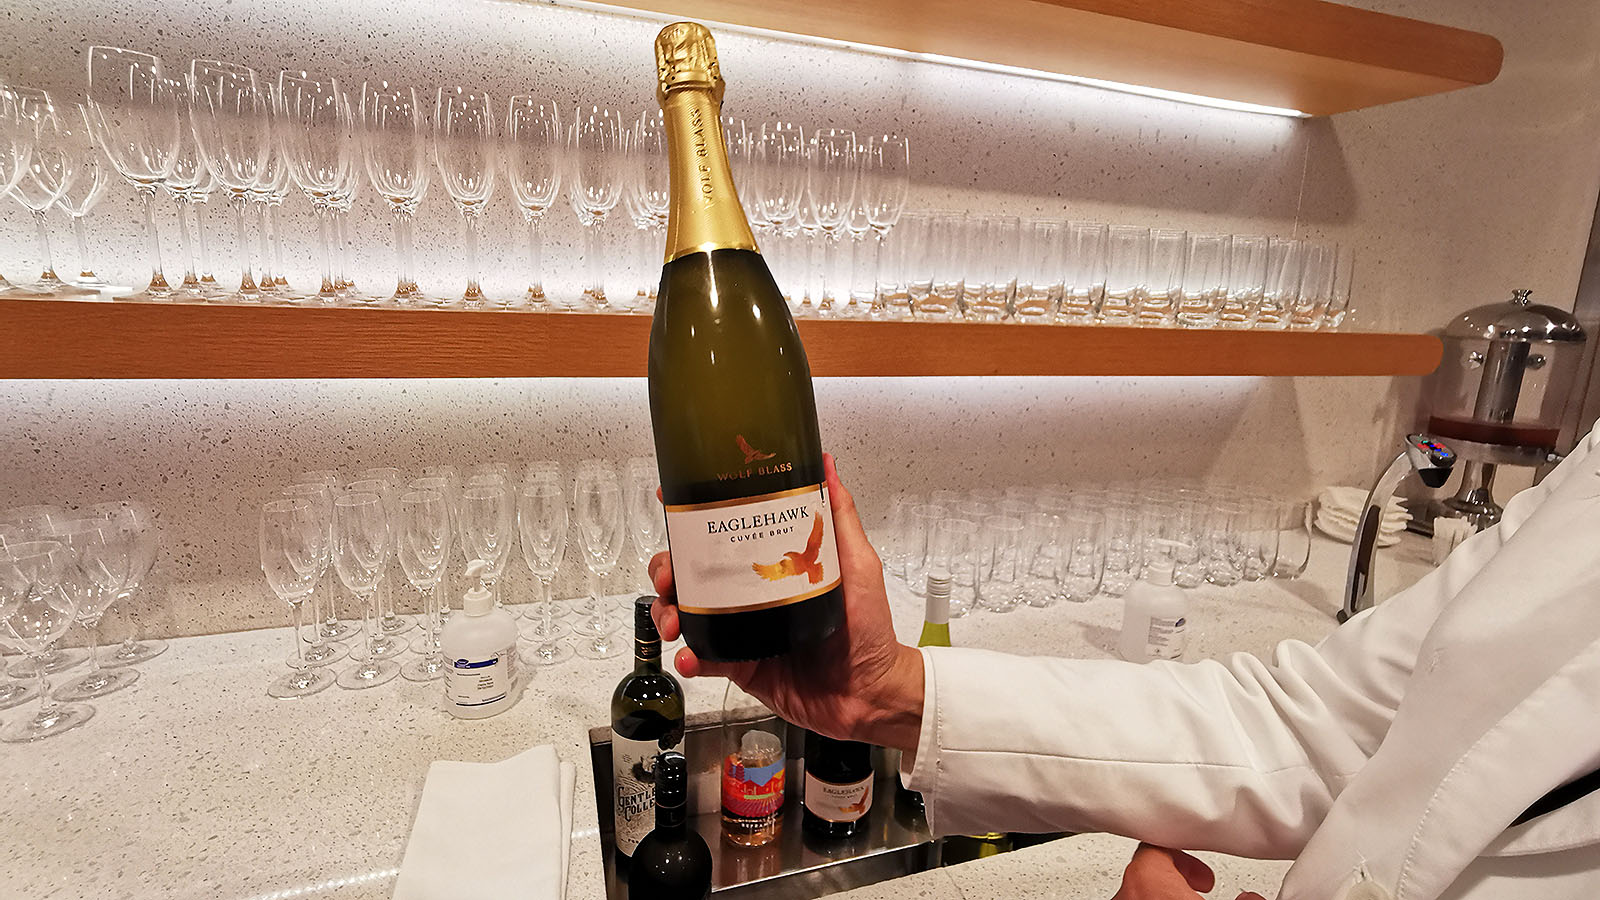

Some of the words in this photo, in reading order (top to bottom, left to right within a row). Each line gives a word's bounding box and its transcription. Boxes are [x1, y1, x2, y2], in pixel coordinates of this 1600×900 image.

[690, 108, 709, 157] BLASS
[715, 468, 752, 481] WOLF
[758, 461, 794, 476] BLASS
[707, 505, 809, 534] EAGLEHAWK
[730, 531, 765, 543] CUVÉE
[769, 525, 795, 537] BRUT
[617, 786, 656, 815] GENTLE
[624, 797, 656, 822] COLLE
